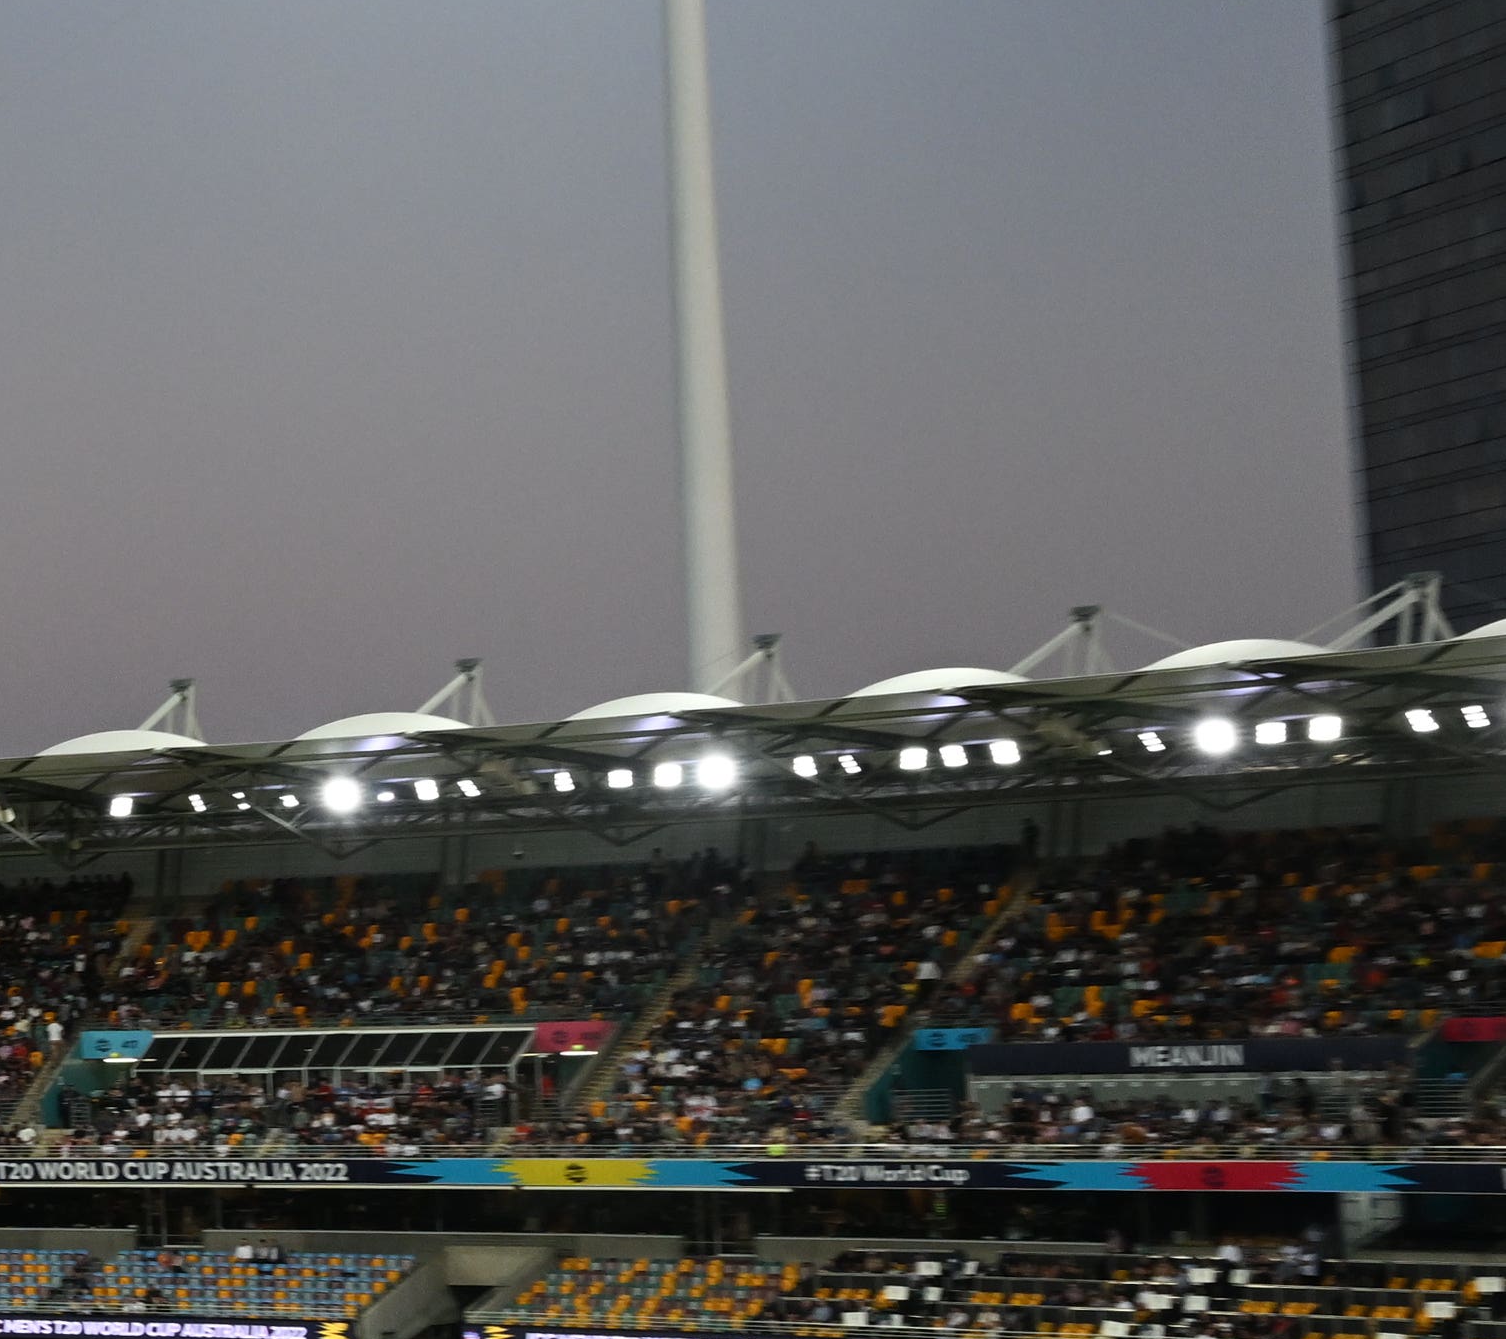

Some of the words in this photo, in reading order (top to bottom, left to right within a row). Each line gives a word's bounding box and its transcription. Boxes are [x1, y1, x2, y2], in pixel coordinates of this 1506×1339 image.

[34, 1162, 119, 1180] WORLD
[122, 1162, 170, 1180] CUP
[171, 1162, 295, 1180] AUSTRALIA
[297, 1162, 349, 1180] 2022
